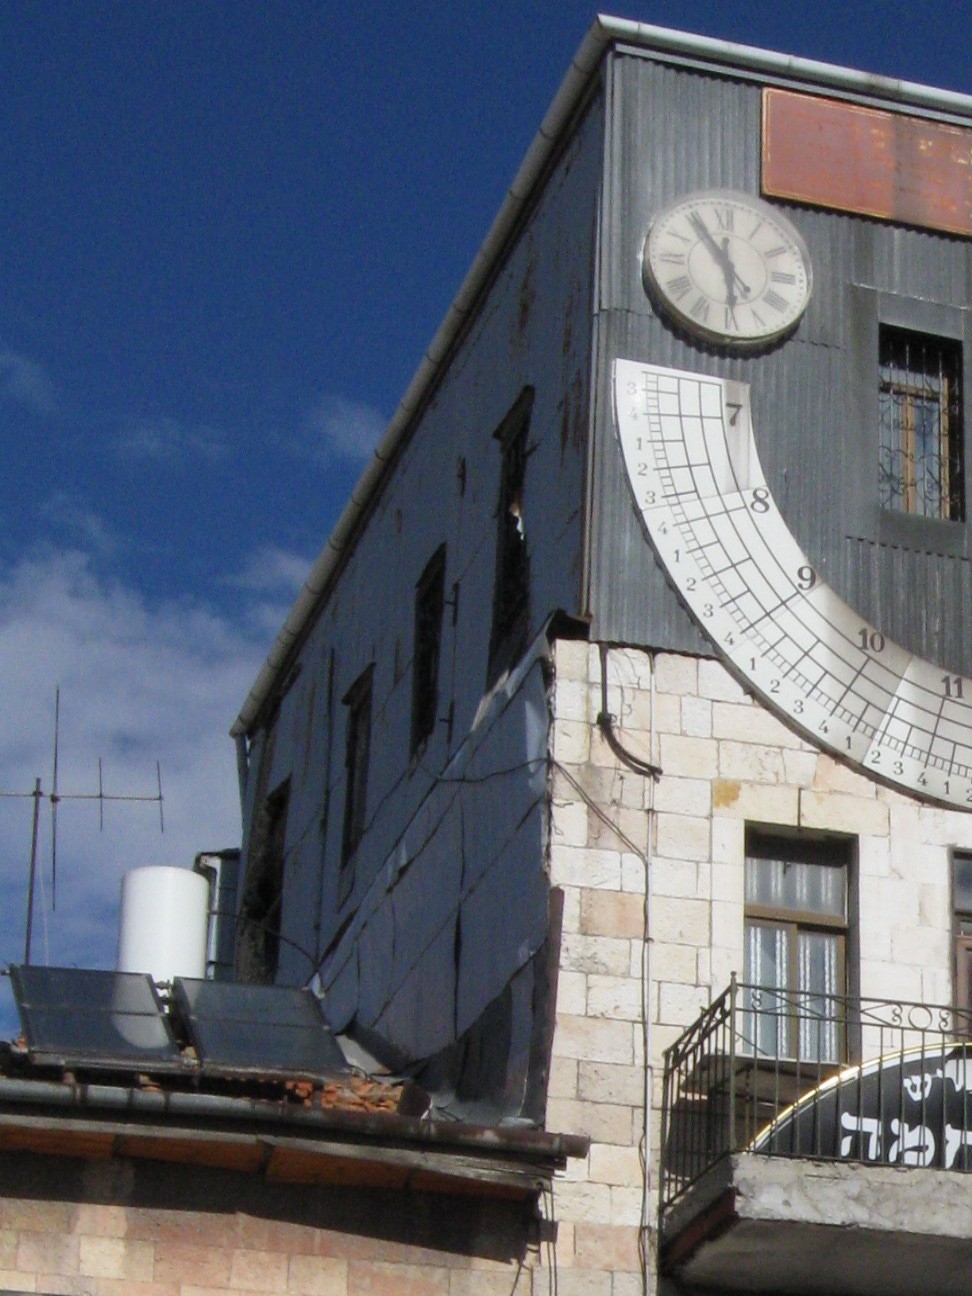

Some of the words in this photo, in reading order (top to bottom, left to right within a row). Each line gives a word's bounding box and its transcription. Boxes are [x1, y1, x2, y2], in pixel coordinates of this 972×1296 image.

[636, 438, 642, 450] 1
[637, 464, 648, 476] 2
[644, 492, 656, 504] 3
[660, 522, 668, 534] 4
[674, 550, 680, 562] 1
[724, 403, 743, 427] 7
[750, 488, 770, 514] 8
[797, 566, 816, 590] 9
[858, 629, 884, 653] 10
[941, 676, 963, 699] 11
[686, 578, 697, 591] 2
[702, 604, 714, 617] 3
[723, 632, 735, 645] 4
[749, 657, 756, 671] 1
[770, 680, 781, 693] 2
[793, 700, 805, 713] 3
[818, 720, 830, 734] 4
[845, 736, 852, 749] 1
[870, 751, 882, 764] 2
[893, 762, 905, 775] 3
[916, 772, 929, 786] 4
[943, 781, 950, 795] 1
